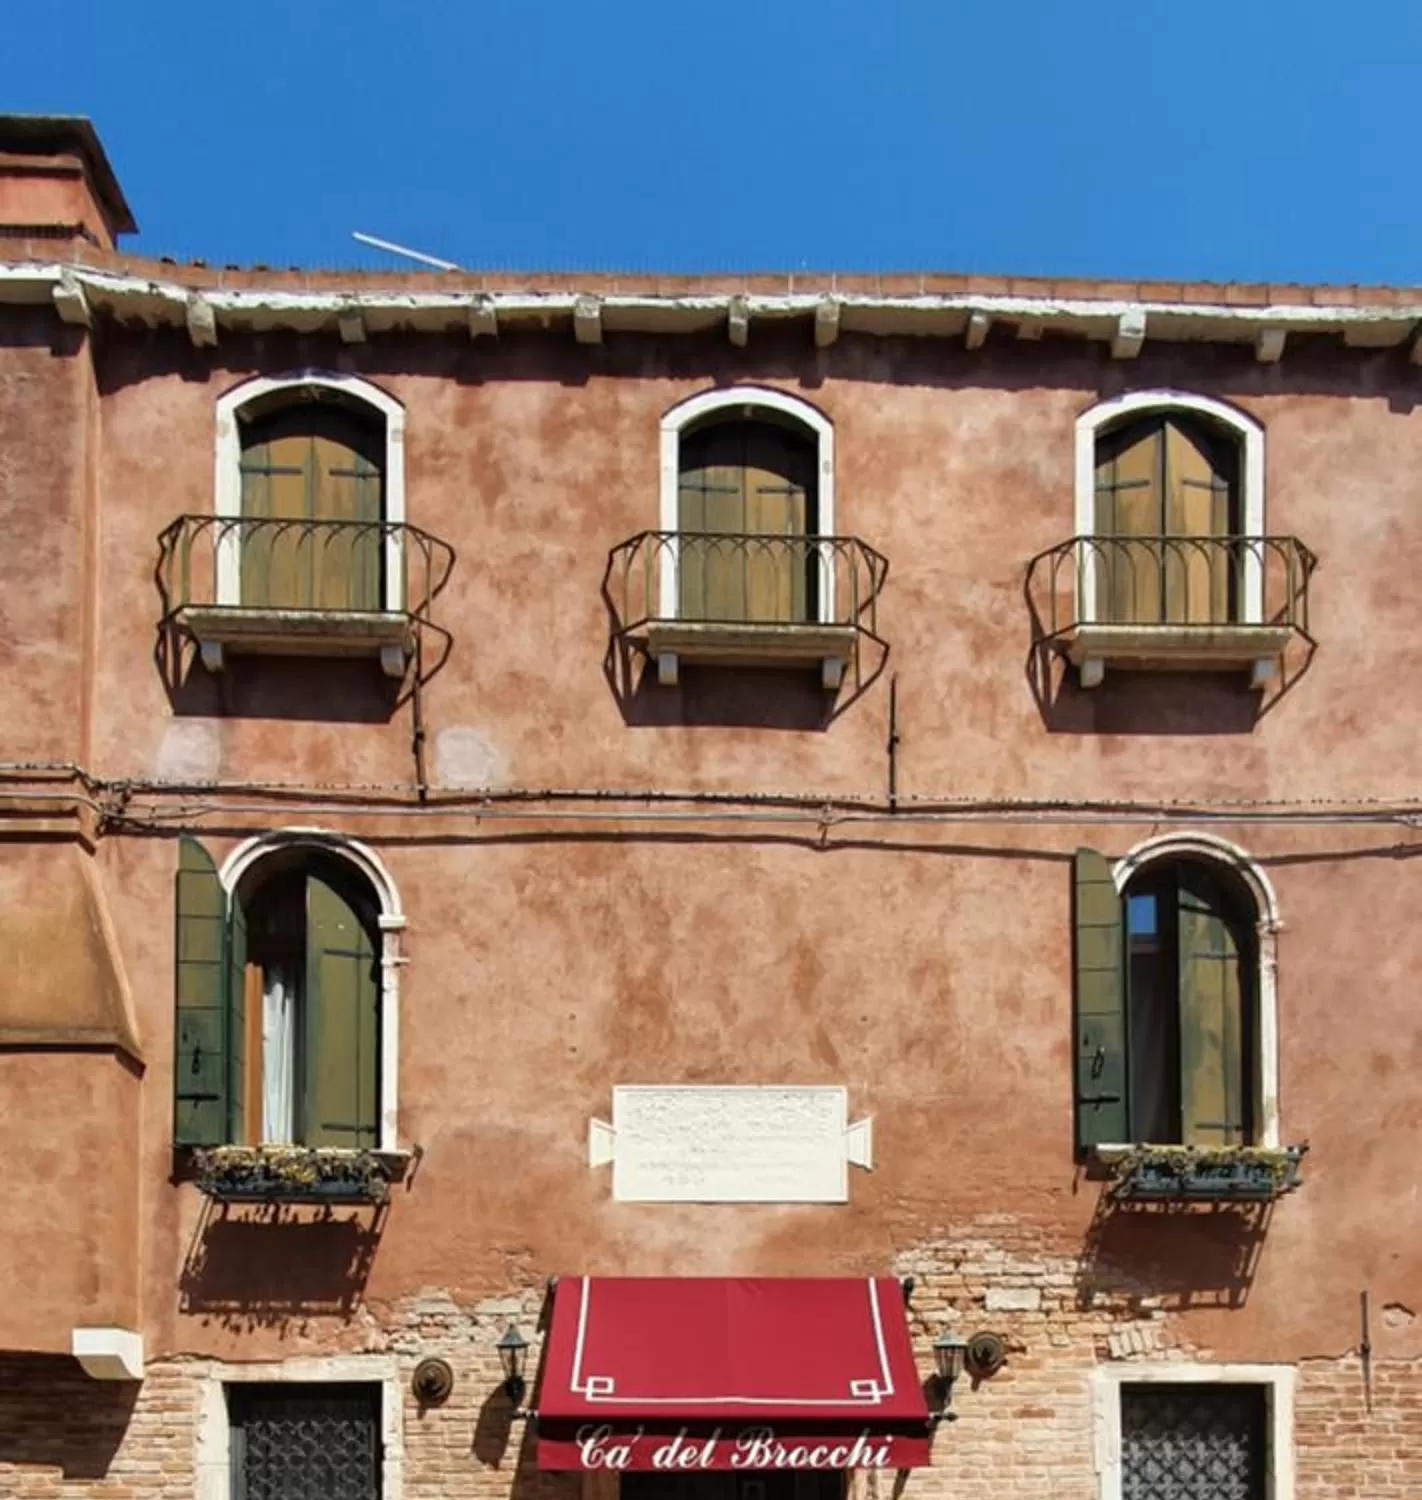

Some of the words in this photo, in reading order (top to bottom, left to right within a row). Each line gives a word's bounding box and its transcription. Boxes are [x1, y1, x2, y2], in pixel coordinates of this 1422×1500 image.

[576, 1423, 642, 1469] Ca'
[653, 1426, 721, 1469] del
[731, 1426, 893, 1469] Brocchi
